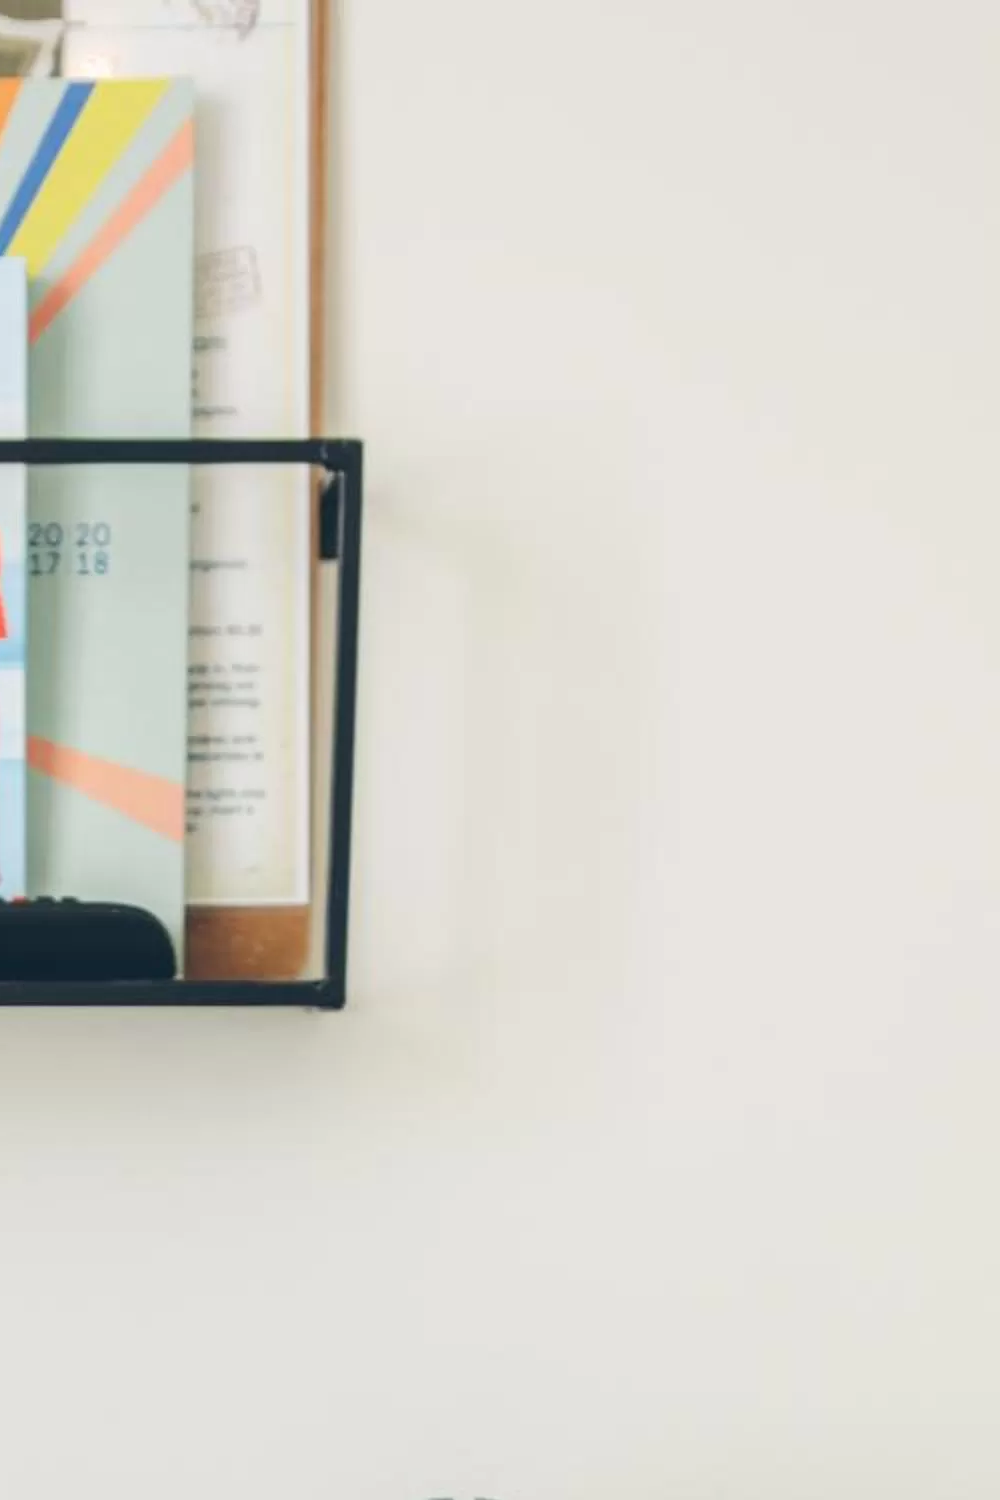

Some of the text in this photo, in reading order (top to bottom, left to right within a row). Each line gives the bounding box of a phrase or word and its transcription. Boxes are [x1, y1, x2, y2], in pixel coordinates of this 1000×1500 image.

[27, 521, 111, 548] 20 20
[28, 550, 61, 576] 17
